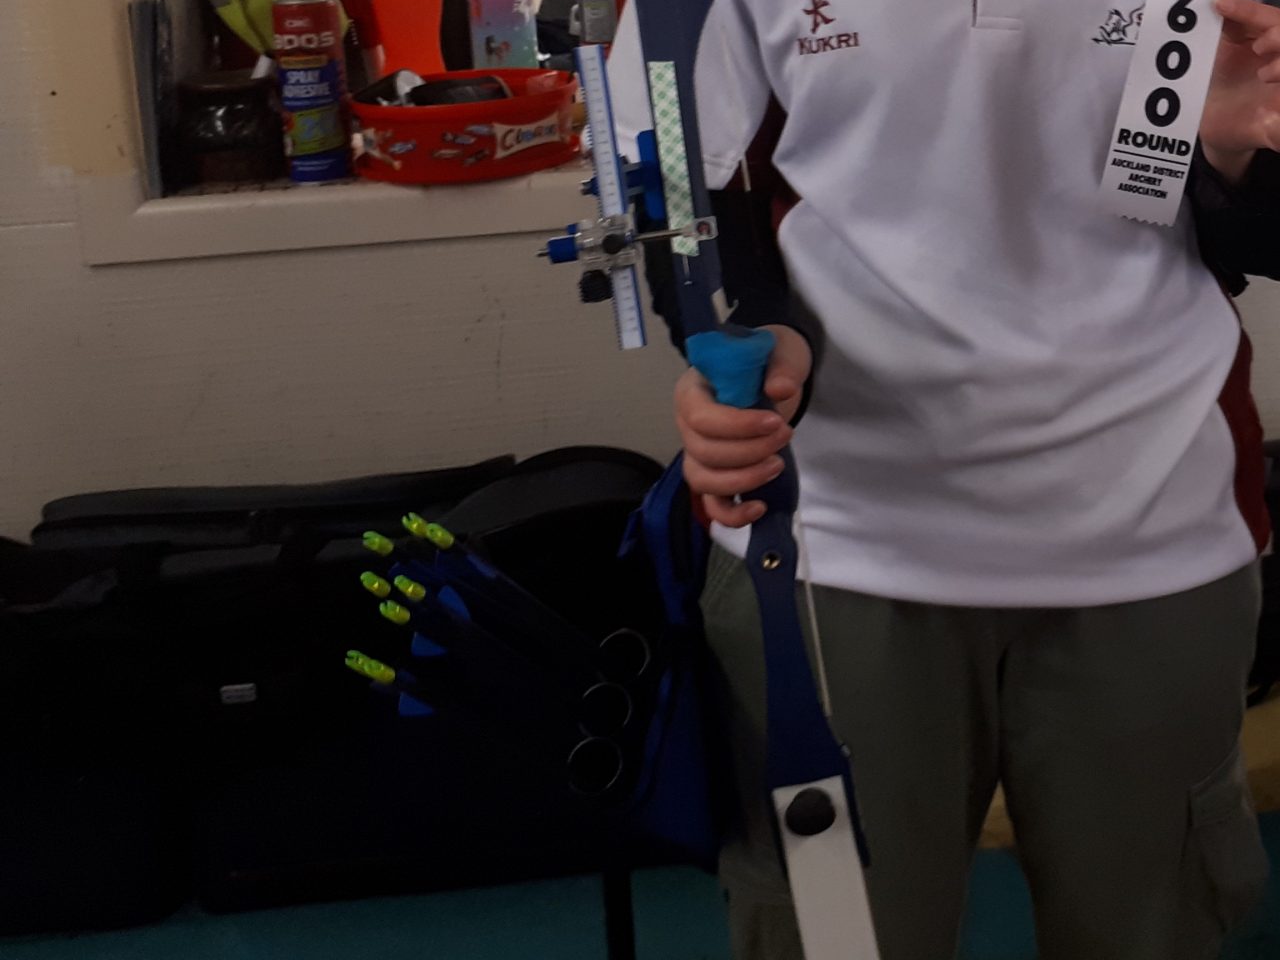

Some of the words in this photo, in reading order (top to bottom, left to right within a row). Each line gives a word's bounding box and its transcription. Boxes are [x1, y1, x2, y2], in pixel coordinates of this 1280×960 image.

[797, 32, 860, 55] KUKRI
[286, 70, 320, 84] SPRAY
[1117, 128, 1191, 156] ROUND
[1111, 157, 1151, 172] AUCKLAND
[1152, 165, 1185, 179] DISTRICT
[1128, 173, 1163, 186] ARCHERY
[1117, 182, 1168, 199] ASSOCIATION
